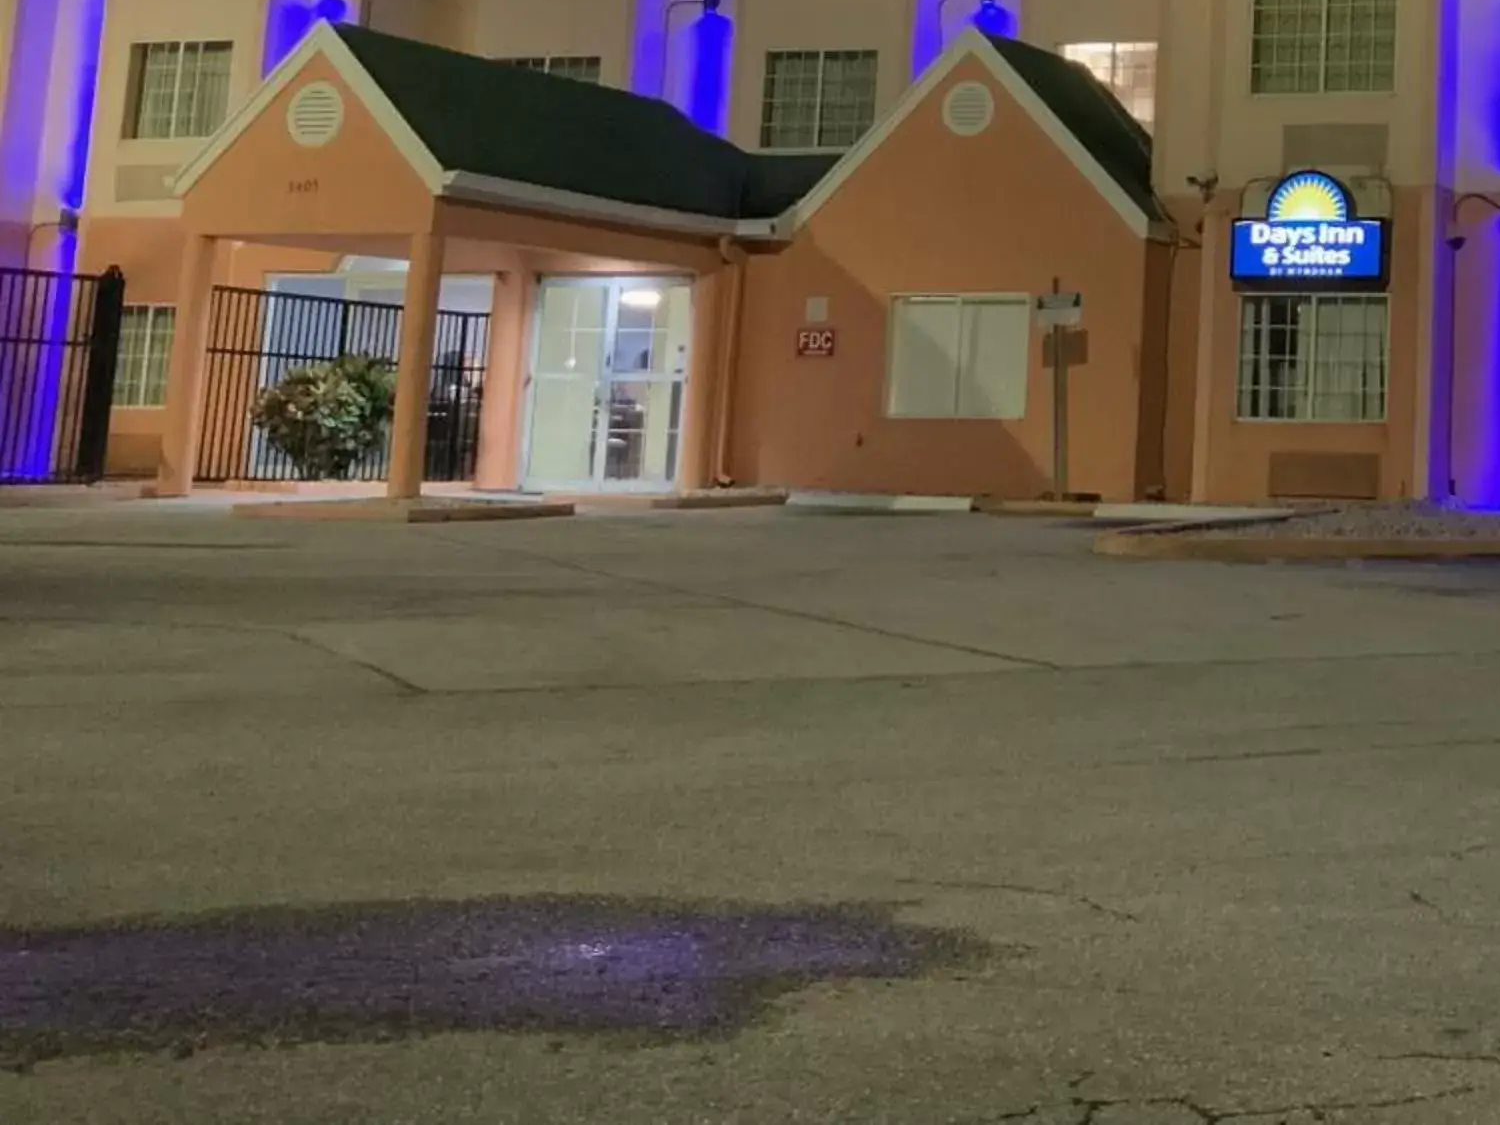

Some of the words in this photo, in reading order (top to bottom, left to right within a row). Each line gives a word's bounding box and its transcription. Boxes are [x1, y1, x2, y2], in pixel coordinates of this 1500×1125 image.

[1251, 223, 1315, 246] Days
[1318, 223, 1364, 244] Inn
[1262, 247, 1279, 265] &
[1281, 245, 1351, 265] Suites
[799, 331, 832, 348] FDC
